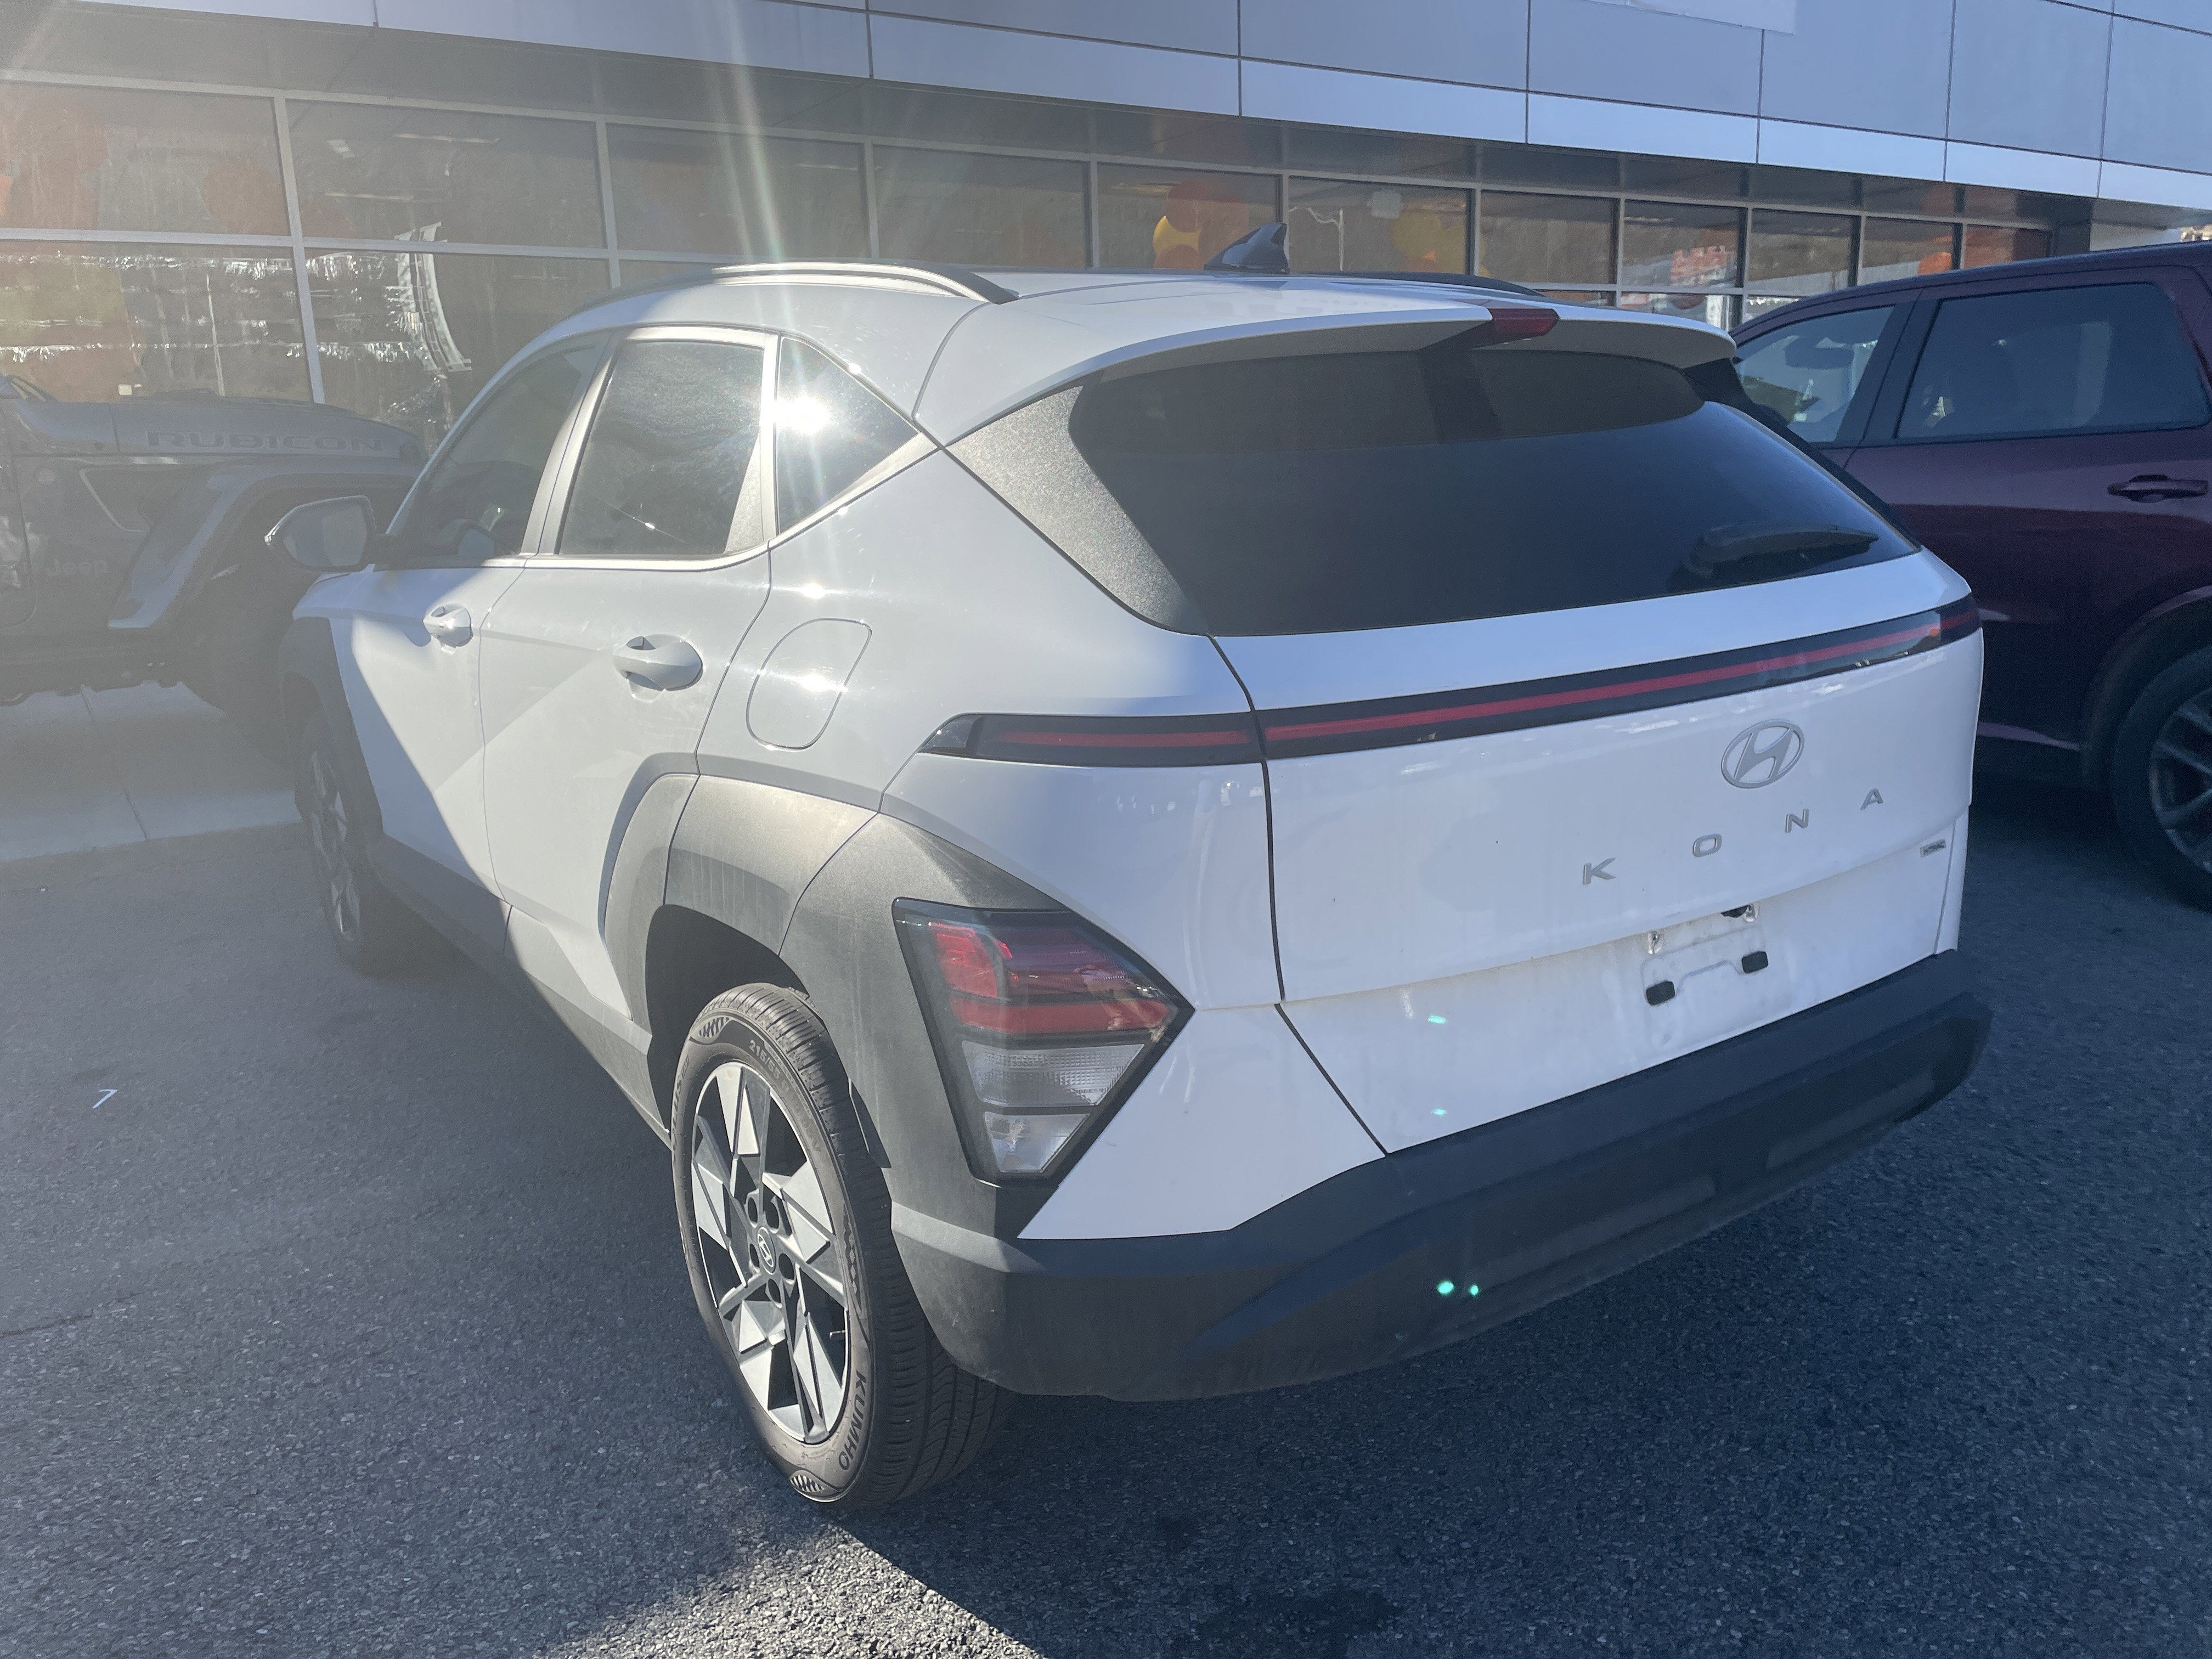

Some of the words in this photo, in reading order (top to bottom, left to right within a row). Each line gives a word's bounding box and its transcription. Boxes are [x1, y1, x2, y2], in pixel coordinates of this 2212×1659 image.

[147, 431, 383, 452] RUBICON
[45, 558, 109, 577] Jeep
[1583, 788, 1884, 885] KONA
[748, 1039, 782, 1080] 215/55
[838, 1370, 866, 1470] KUMHO
